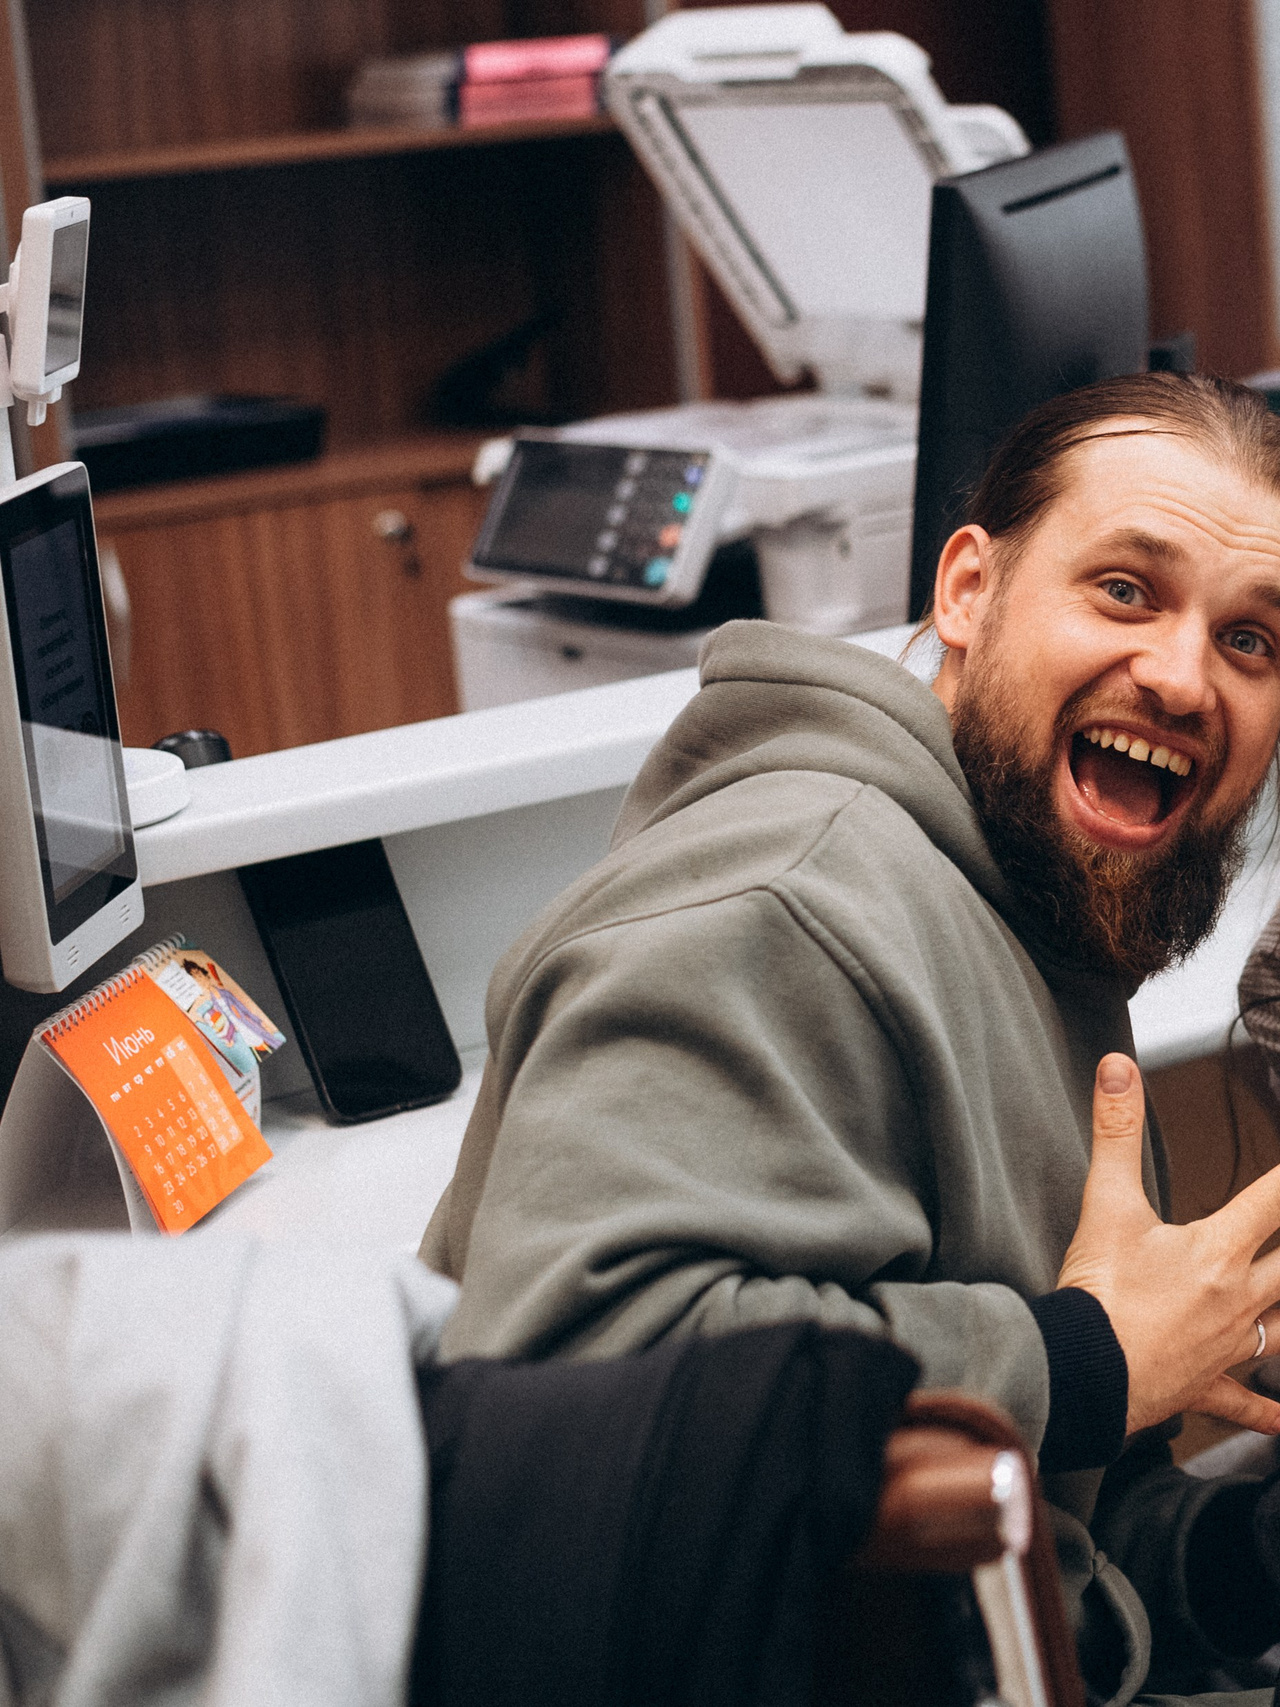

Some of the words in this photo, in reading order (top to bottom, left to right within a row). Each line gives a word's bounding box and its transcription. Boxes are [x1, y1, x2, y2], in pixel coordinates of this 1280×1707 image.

[102, 1027, 156, 1066] Июнь
[133, 1073, 144, 1086] ср
[165, 1045, 176, 1060] сб
[134, 1126, 143, 1138] 2
[145, 1117, 154, 1128] 3
[157, 1108, 165, 1119] 4
[167, 1098, 176, 1111] 5
[178, 1091, 187, 1103] 6
[188, 1081, 196, 1093] 7
[144, 1144, 153, 1156] 9
[154, 1134, 166, 1147] 10
[166, 1125, 176, 1137] 11
[176, 1117, 187, 1130] 12
[187, 1108, 198, 1120] 13
[154, 1162, 164, 1176] 16
[165, 1152, 175, 1165] 17
[176, 1143, 187, 1156] 18
[187, 1134, 197, 1148] 19
[197, 1125, 209, 1140] 20
[163, 1180, 175, 1196] 23
[175, 1171, 186, 1186] 24
[186, 1161, 197, 1177] 25
[196, 1153, 208, 1168] 26
[207, 1143, 218, 1158] 27
[172, 1199, 184, 1214] 30
